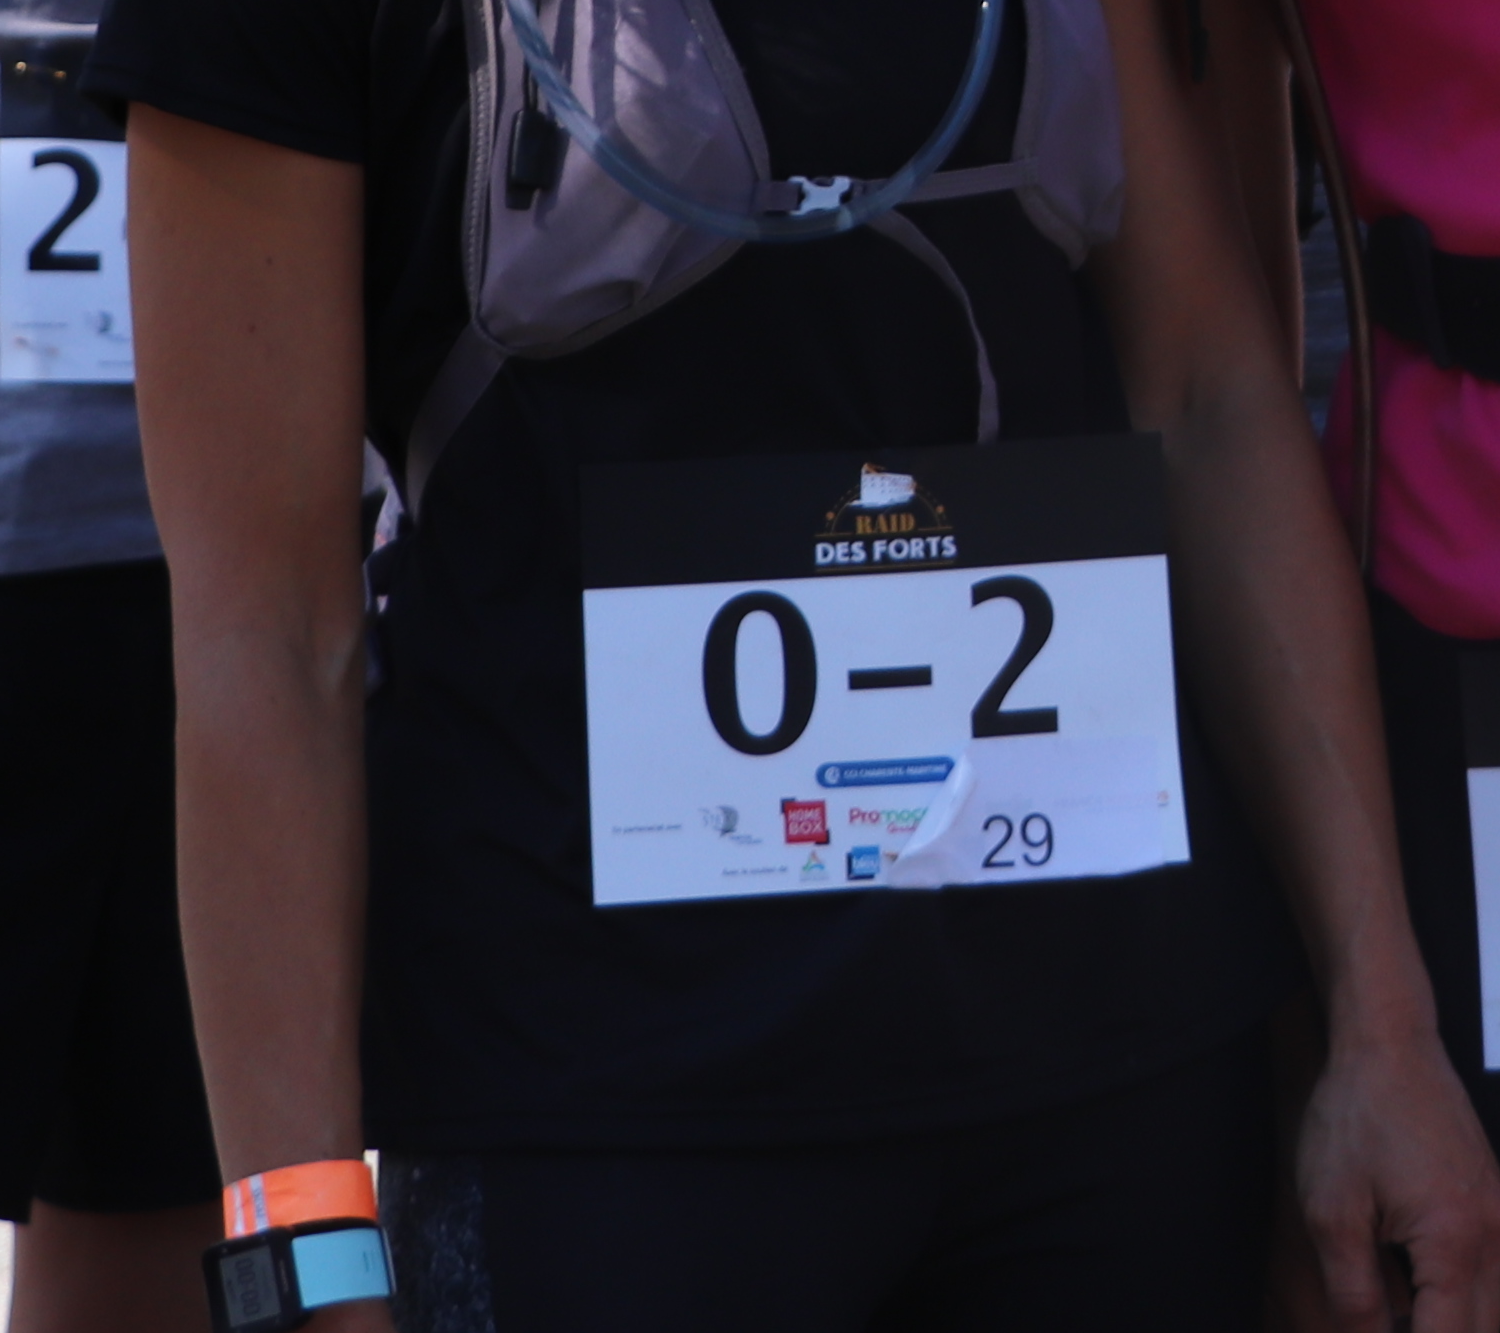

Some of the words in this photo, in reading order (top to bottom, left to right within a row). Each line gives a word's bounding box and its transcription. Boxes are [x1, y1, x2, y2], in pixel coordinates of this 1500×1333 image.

[28, 147, 103, 272] 2
[856, 514, 915, 534] RAID
[815, 541, 867, 566] DES
[873, 536, 958, 562] FORTS
[703, 574, 1059, 757] 0-2
[788, 821, 824, 835] BOX
[981, 813, 1054, 869] 29
